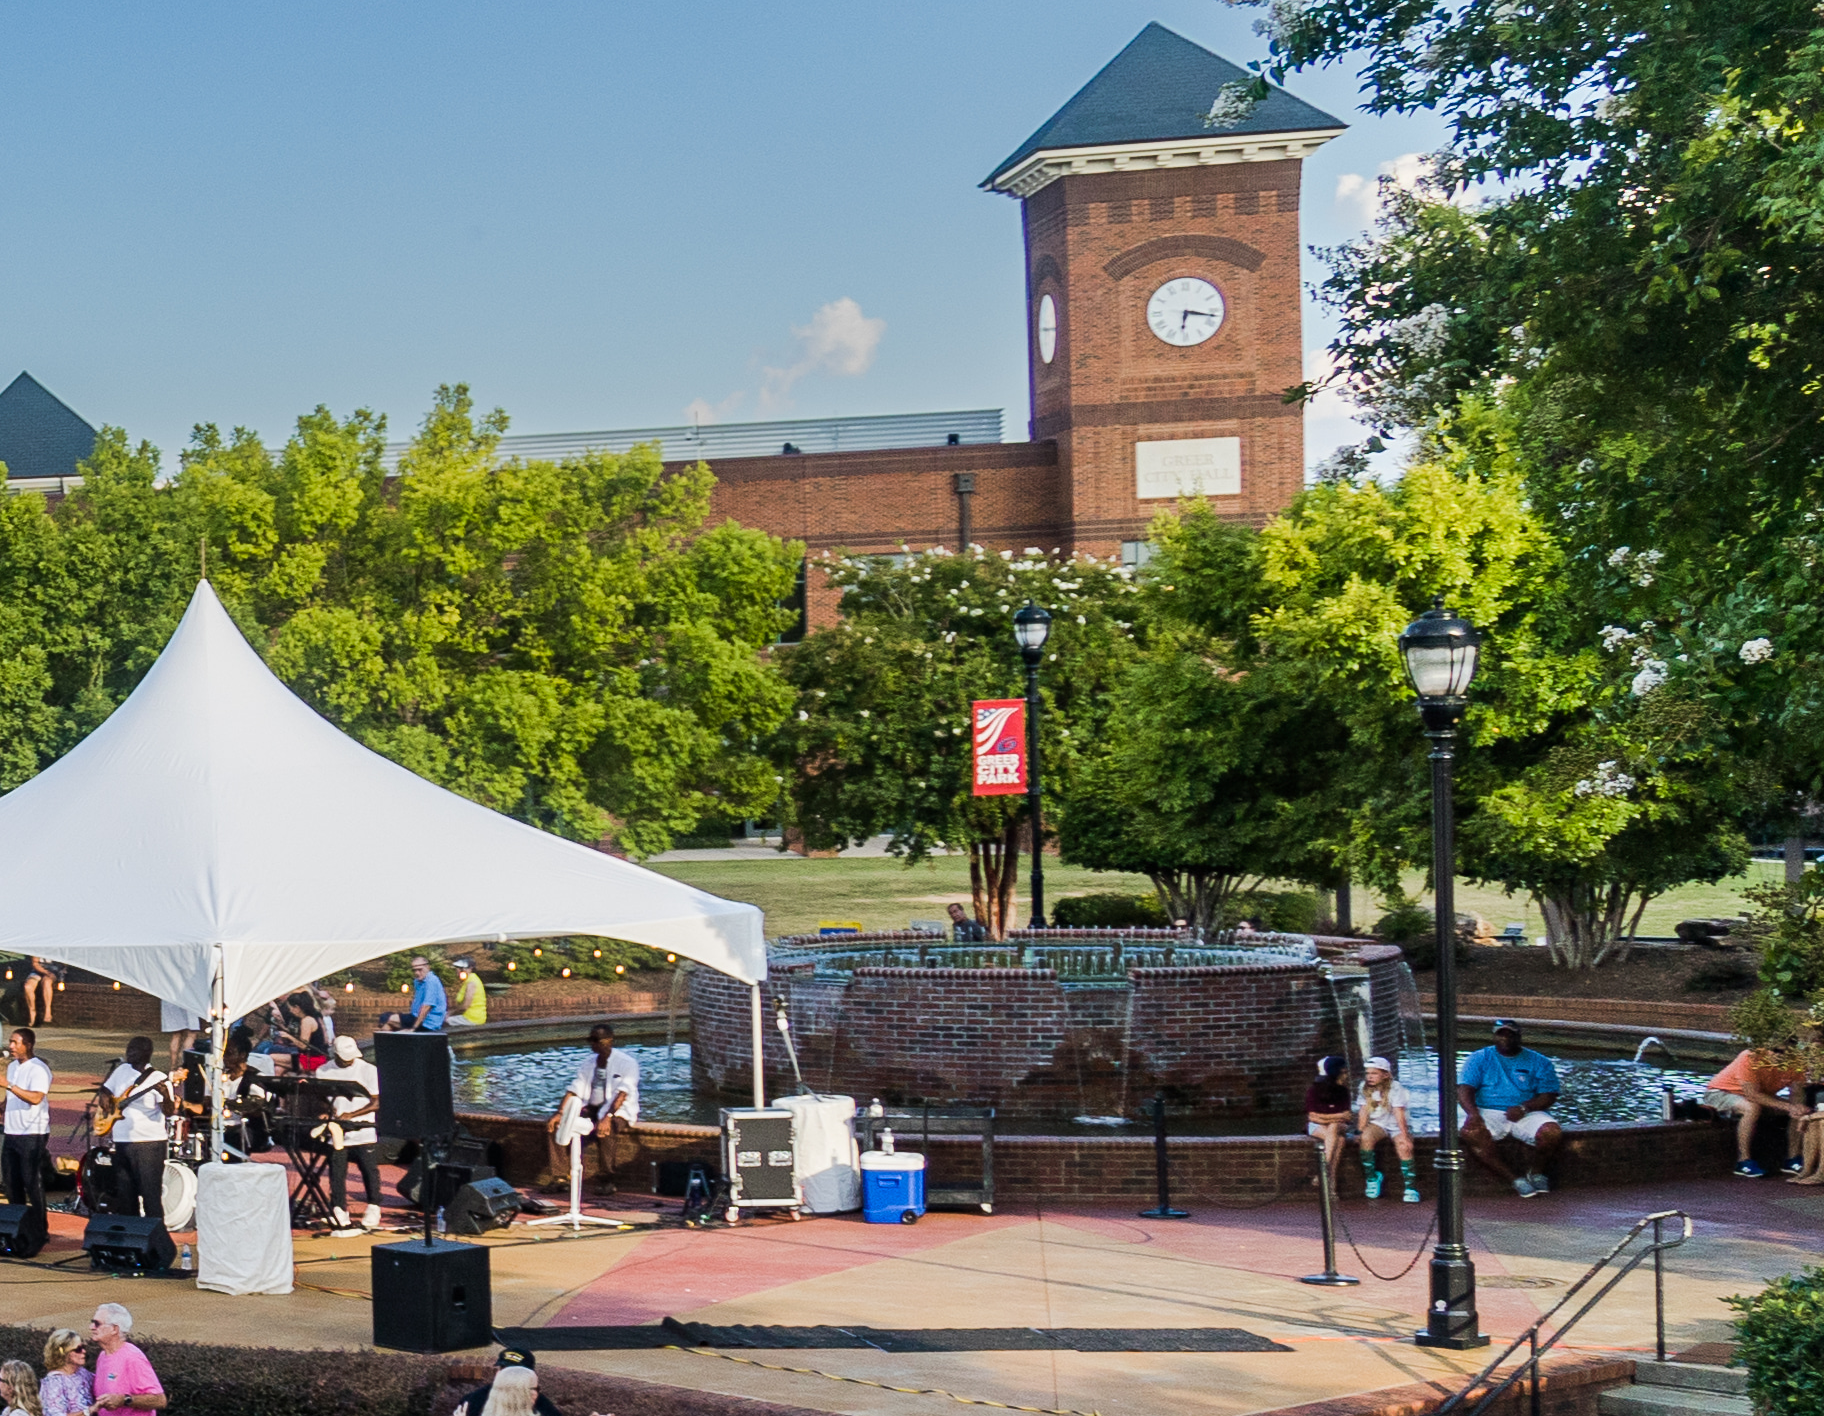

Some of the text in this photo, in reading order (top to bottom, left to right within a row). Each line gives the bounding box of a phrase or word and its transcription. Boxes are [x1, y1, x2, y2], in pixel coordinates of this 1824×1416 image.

[1162, 453, 1214, 467] GREER
[1144, 468, 1234, 483] CITY HALL
[976, 754, 1020, 766] GREER
[976, 763, 1019, 775] CITY
[977, 773, 1021, 785] PARK
